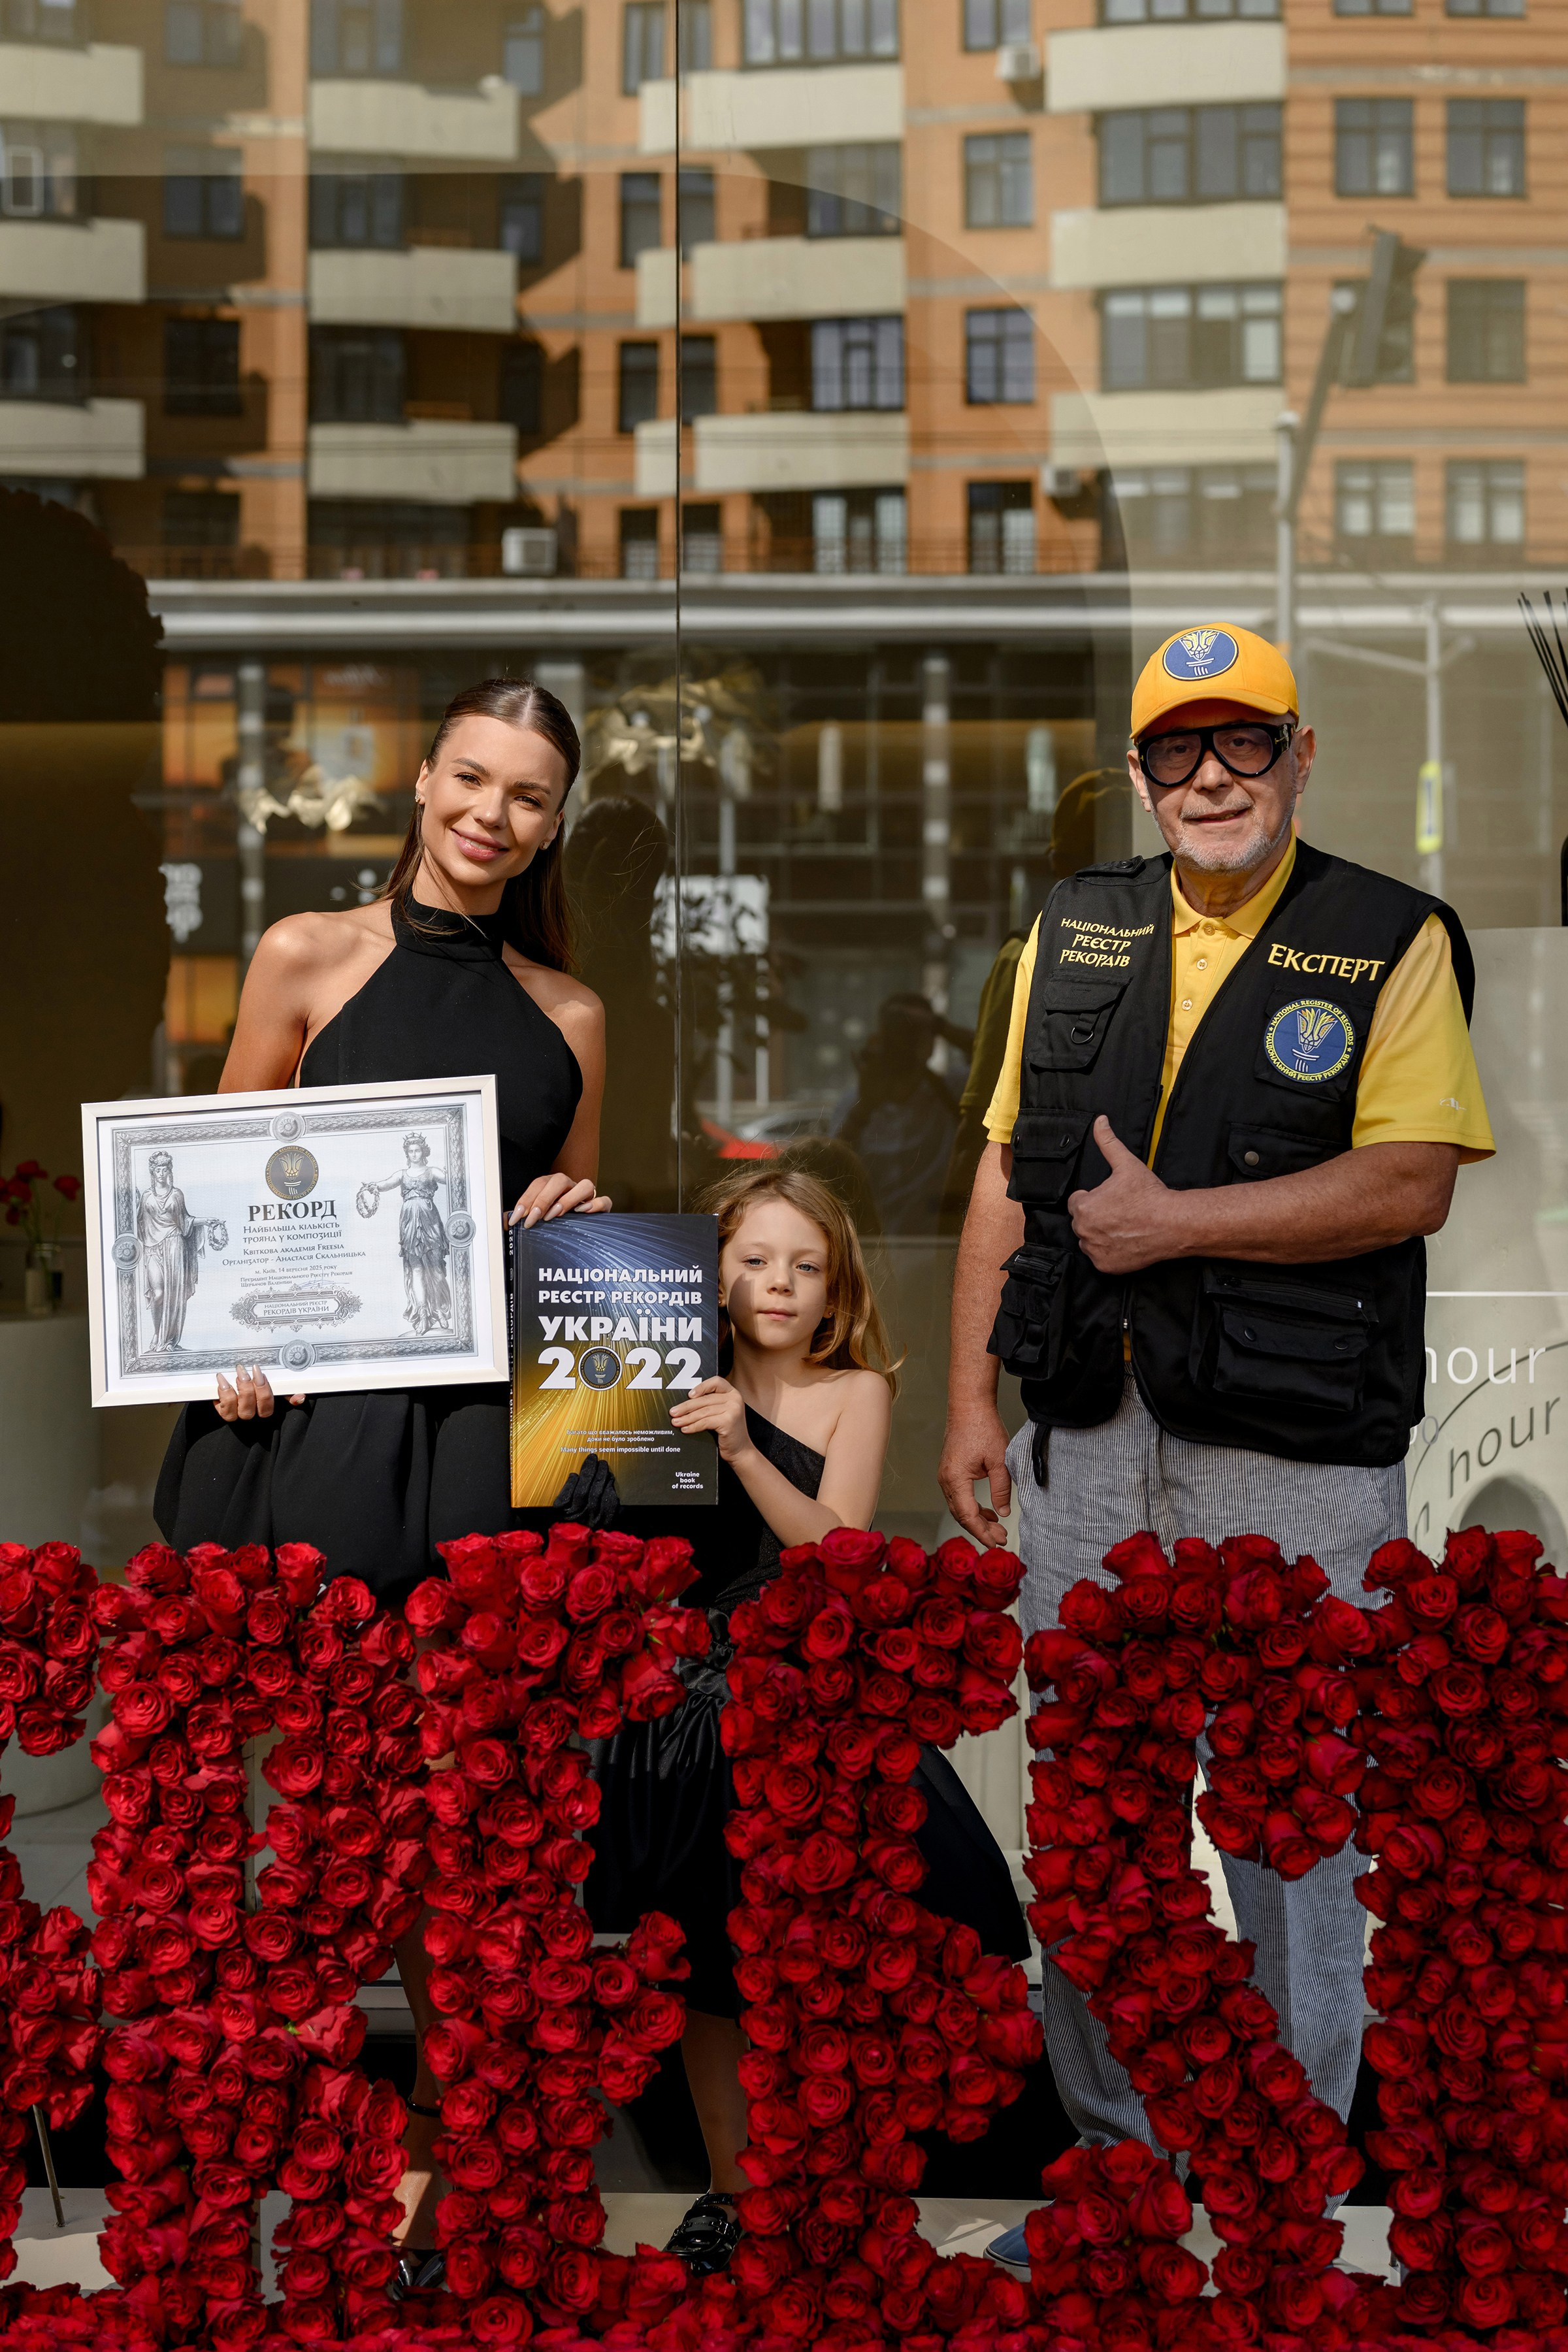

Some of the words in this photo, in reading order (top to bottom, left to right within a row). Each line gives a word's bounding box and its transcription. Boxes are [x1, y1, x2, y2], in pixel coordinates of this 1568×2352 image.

[1060, 918, 1154, 938] НАЦІОНАЛЬНИЙ
[1071, 934, 1131, 953] РЕЄСТР
[1059, 949, 1131, 968] РЕКОРДІВ
[1267, 943, 1386, 984] ЕКСПЕРТ
[1271, 1002, 1300, 1026] NATIONAL
[1300, 1000, 1337, 1011] REGISTER
[1333, 1007, 1343, 1015] OF
[1340, 1013, 1354, 1046] RECORDS
[1266, 1032, 1297, 1079] НАЦІОНАЛЬНИЙ
[1323, 1053, 1350, 1079] РЕКОРДІВ
[248, 1200, 337, 1222] РЕКОРД
[538, 1265, 702, 1284] НАЦІОНАЛЬНИЙ
[538, 1290, 606, 1303] РЕЄСТР
[611, 1291, 702, 1306] РЕКОРДІВ
[538, 1308, 702, 1342] УКРАЇНИ
